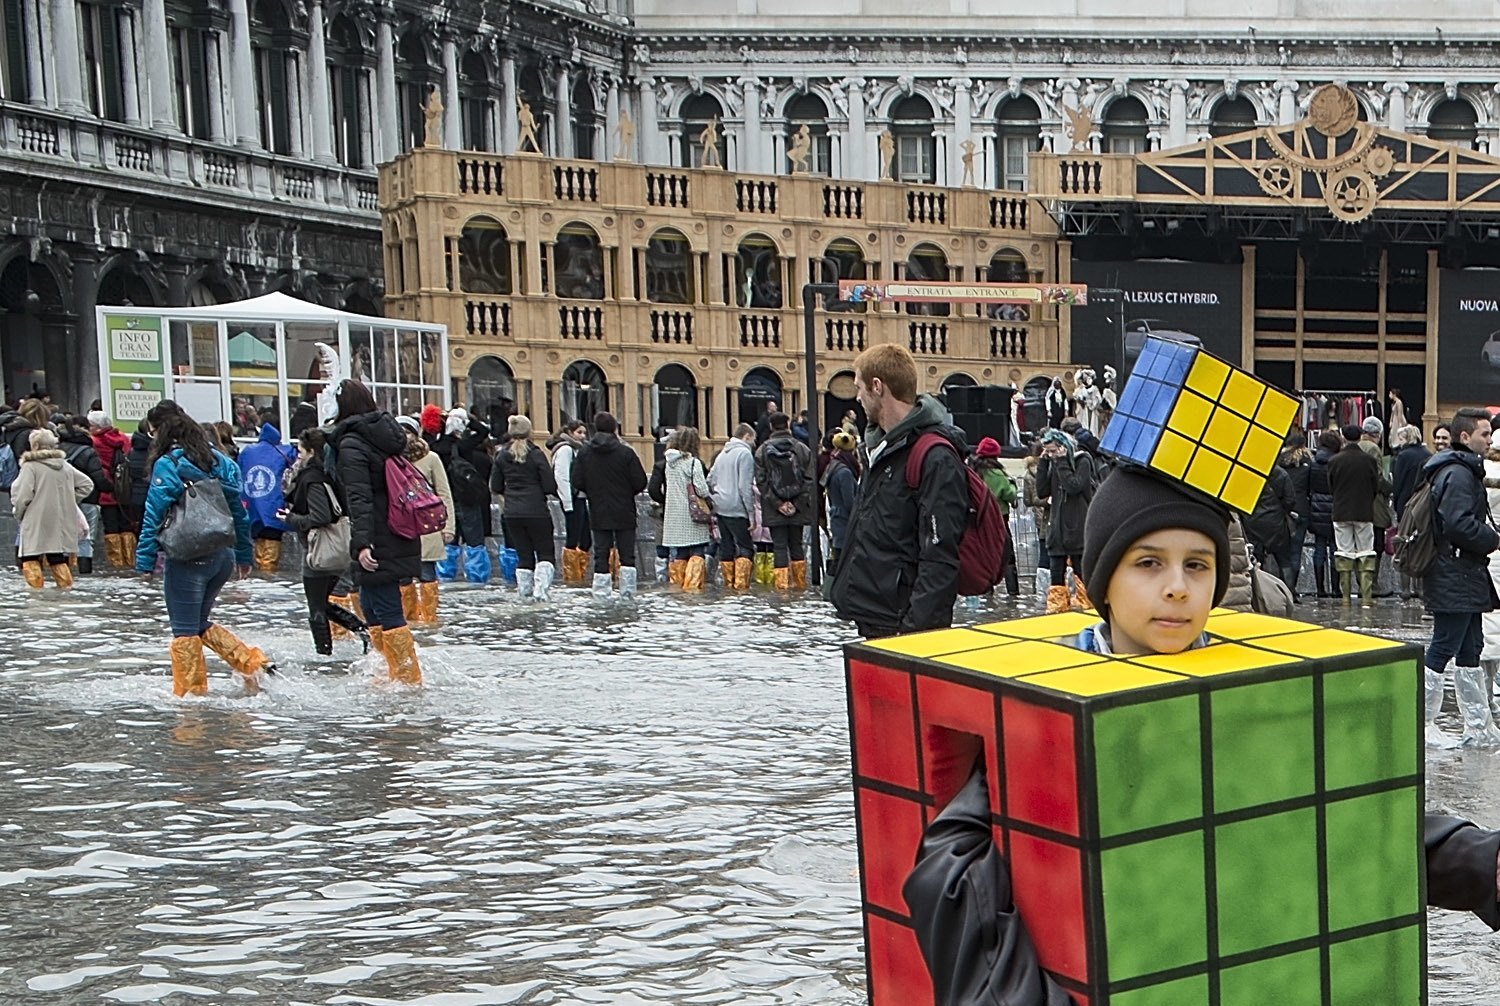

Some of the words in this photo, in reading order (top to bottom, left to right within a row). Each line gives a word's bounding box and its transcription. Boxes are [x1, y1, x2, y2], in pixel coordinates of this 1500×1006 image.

[907, 287, 952, 296] ENTRATA
[966, 288, 1018, 297] ENTRANCE
[1132, 291, 1163, 304] LEXUS
[1165, 292, 1178, 304] CT
[1180, 292, 1220, 304] HYBRID.
[1460, 300, 1499, 312] NUOVA
[119, 332, 151, 343] INFO
[119, 343, 151, 352] GRAN
[120, 351, 152, 359] TEATRO
